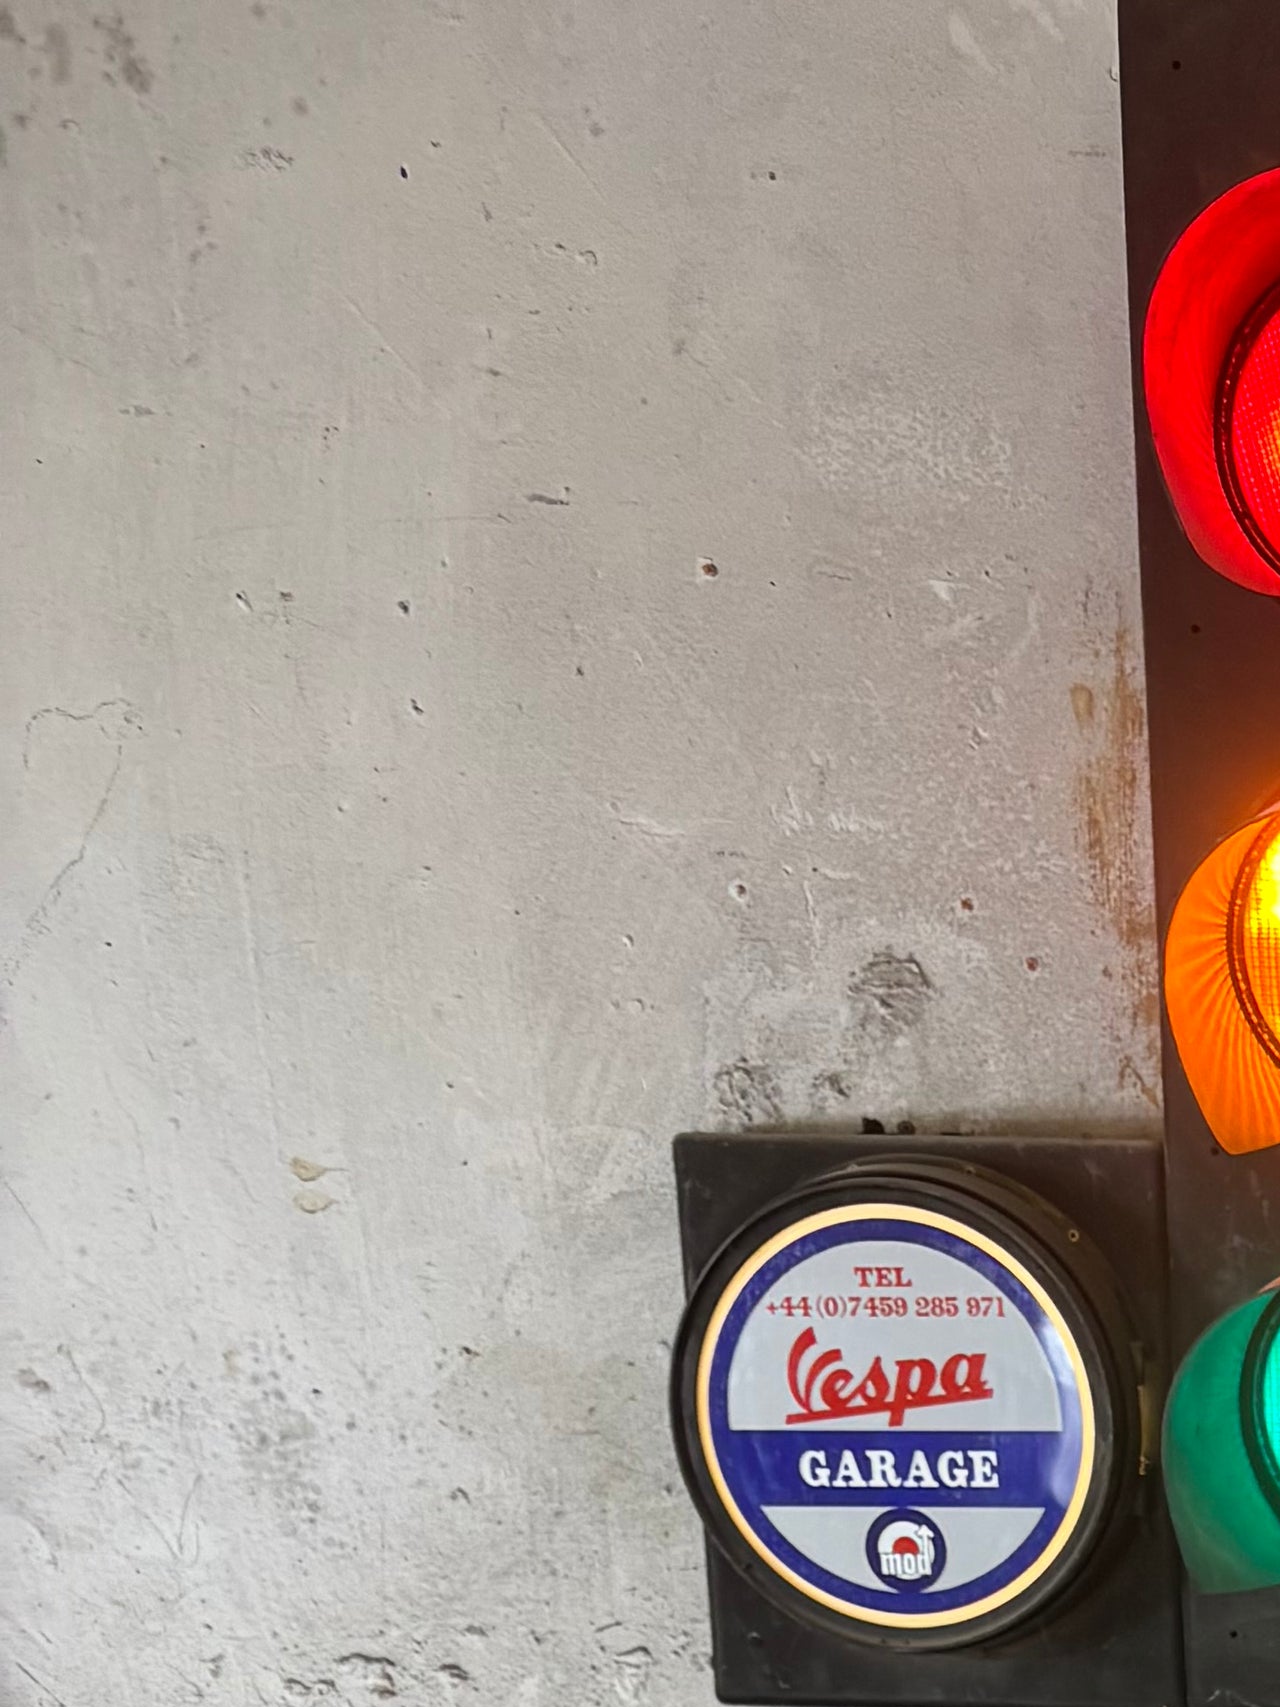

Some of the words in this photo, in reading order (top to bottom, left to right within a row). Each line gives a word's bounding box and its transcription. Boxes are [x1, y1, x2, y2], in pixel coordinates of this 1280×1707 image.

[854, 1267, 912, 1287] TEL
[915, 1296, 959, 1317] 285
[966, 1296, 1006, 1317] 971
[785, 1326, 994, 1427] Vespa
[799, 1449, 1000, 1489] GARAGE
